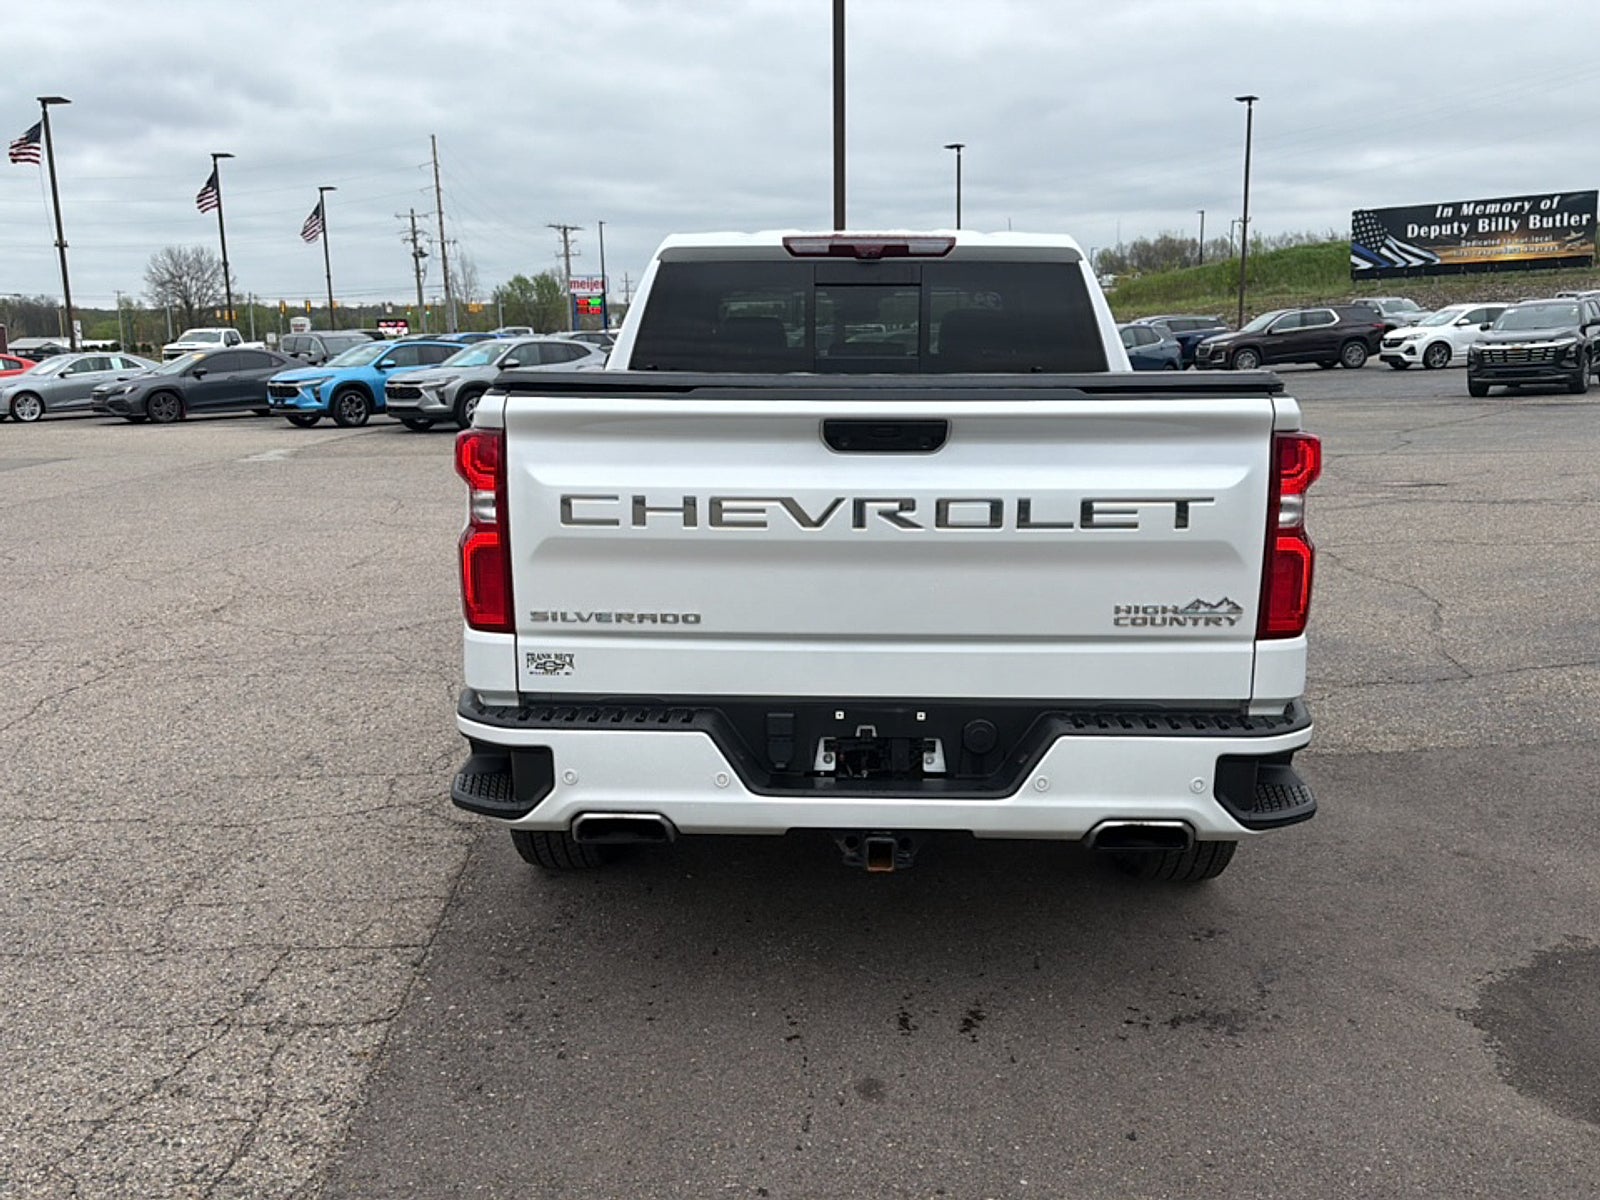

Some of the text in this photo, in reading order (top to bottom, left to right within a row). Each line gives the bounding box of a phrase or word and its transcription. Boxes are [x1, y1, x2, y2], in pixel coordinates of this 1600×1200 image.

[1435, 195, 1561, 218] In Memory of
[1406, 212, 1591, 239] Deputy Billy Butler
[560, 493, 1215, 530] CHEVROLET
[529, 610, 702, 625] SILVERADO
[1113, 604, 1179, 615] HIGH
[1113, 616, 1241, 627] COUNTRY
[526, 652, 553, 668] FRANK
